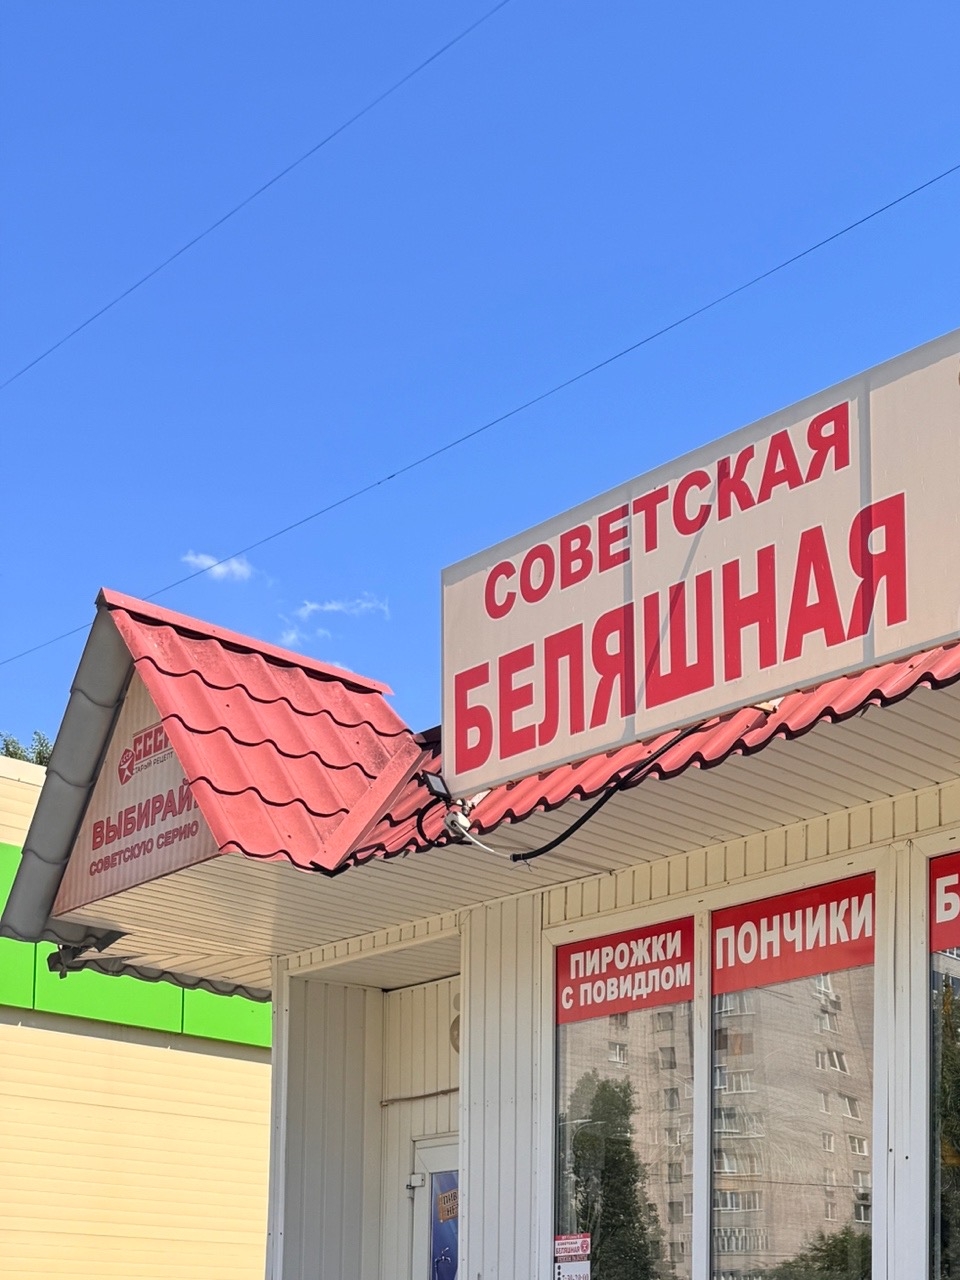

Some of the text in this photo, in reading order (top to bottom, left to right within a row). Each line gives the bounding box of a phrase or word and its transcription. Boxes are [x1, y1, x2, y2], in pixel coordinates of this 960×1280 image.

[483, 400, 851, 620] СОВЕТСКАЯ
[453, 492, 907, 775] БЕЛЯШНАЯ
[89, 820, 199, 877] СОВЕТСКУЮ СЕРИЮ
[570, 930, 682, 980] ПИРОЖКИ
[715, 892, 873, 970] ПОНЧИКИ
[561, 961, 692, 1010] С ПОВИДЛОМ
